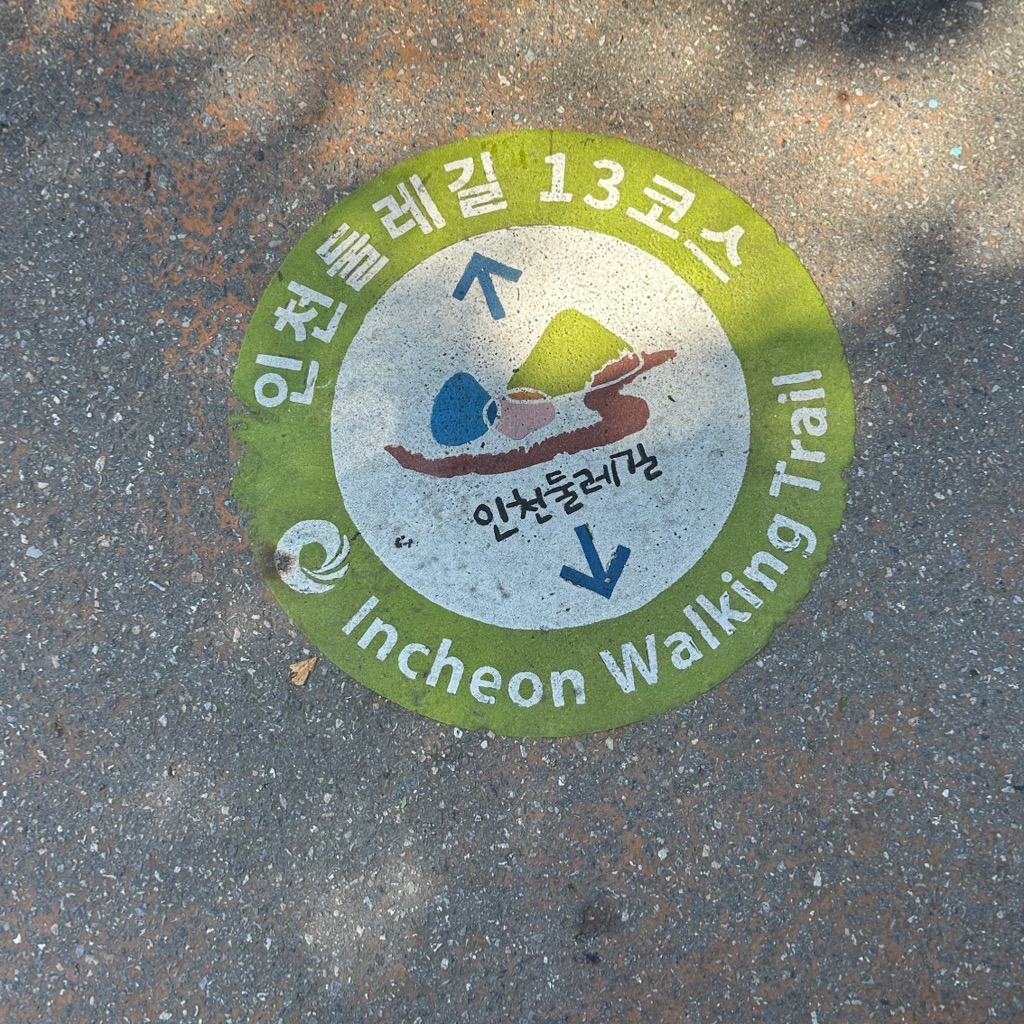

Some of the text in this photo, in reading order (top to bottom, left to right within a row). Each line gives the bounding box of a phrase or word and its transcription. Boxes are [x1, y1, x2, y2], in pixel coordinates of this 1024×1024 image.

[254, 151, 748, 408] 인천둘레길 13코스
[341, 369, 829, 708] Incheon Walking Trail
[473, 442, 663, 541] 인천둘레길
